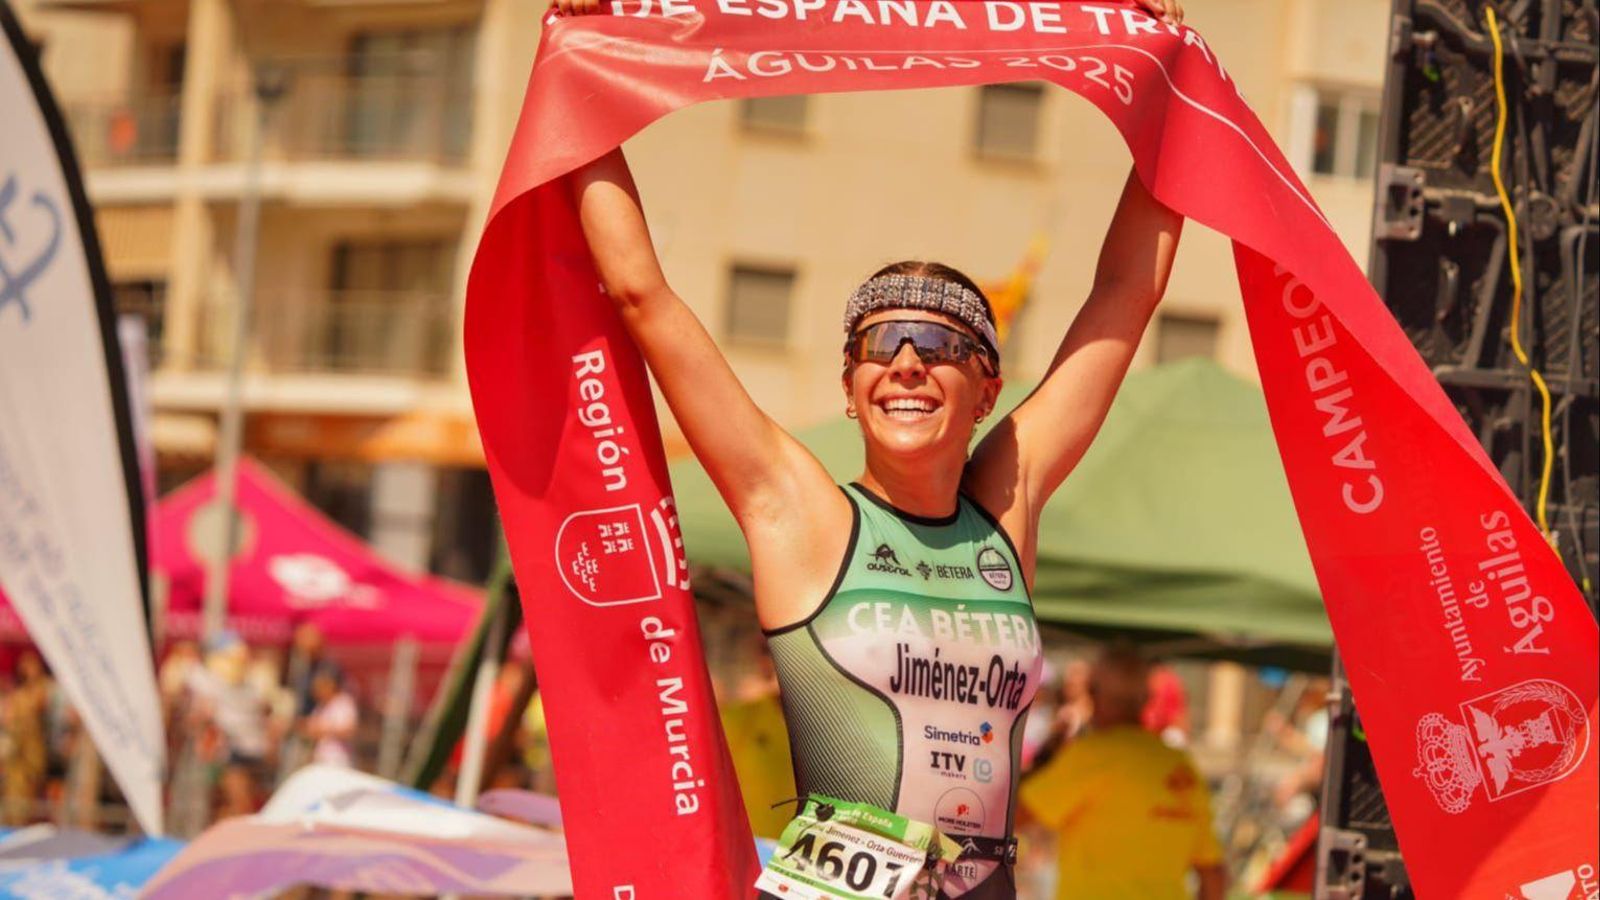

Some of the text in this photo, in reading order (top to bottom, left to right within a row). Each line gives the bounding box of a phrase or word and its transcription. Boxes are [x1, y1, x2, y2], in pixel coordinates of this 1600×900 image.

[984, 1, 1068, 34] DE
[1000, 55, 1134, 106] 2025
[1273, 261, 1384, 514] CAMPEO
[572, 350, 630, 492] Región
[936, 562, 975, 580] BÉTERA
[1464, 579, 1490, 610] de
[1480, 510, 1555, 656] Águilas
[847, 601, 922, 637] CEA
[1419, 526, 1486, 683] Ayuntamiento
[889, 643, 1027, 711] Jiménez-Orta
[640, 616, 705, 816] de Murcia
[924, 725, 981, 746] Simetria
[930, 751, 966, 773] ITV
